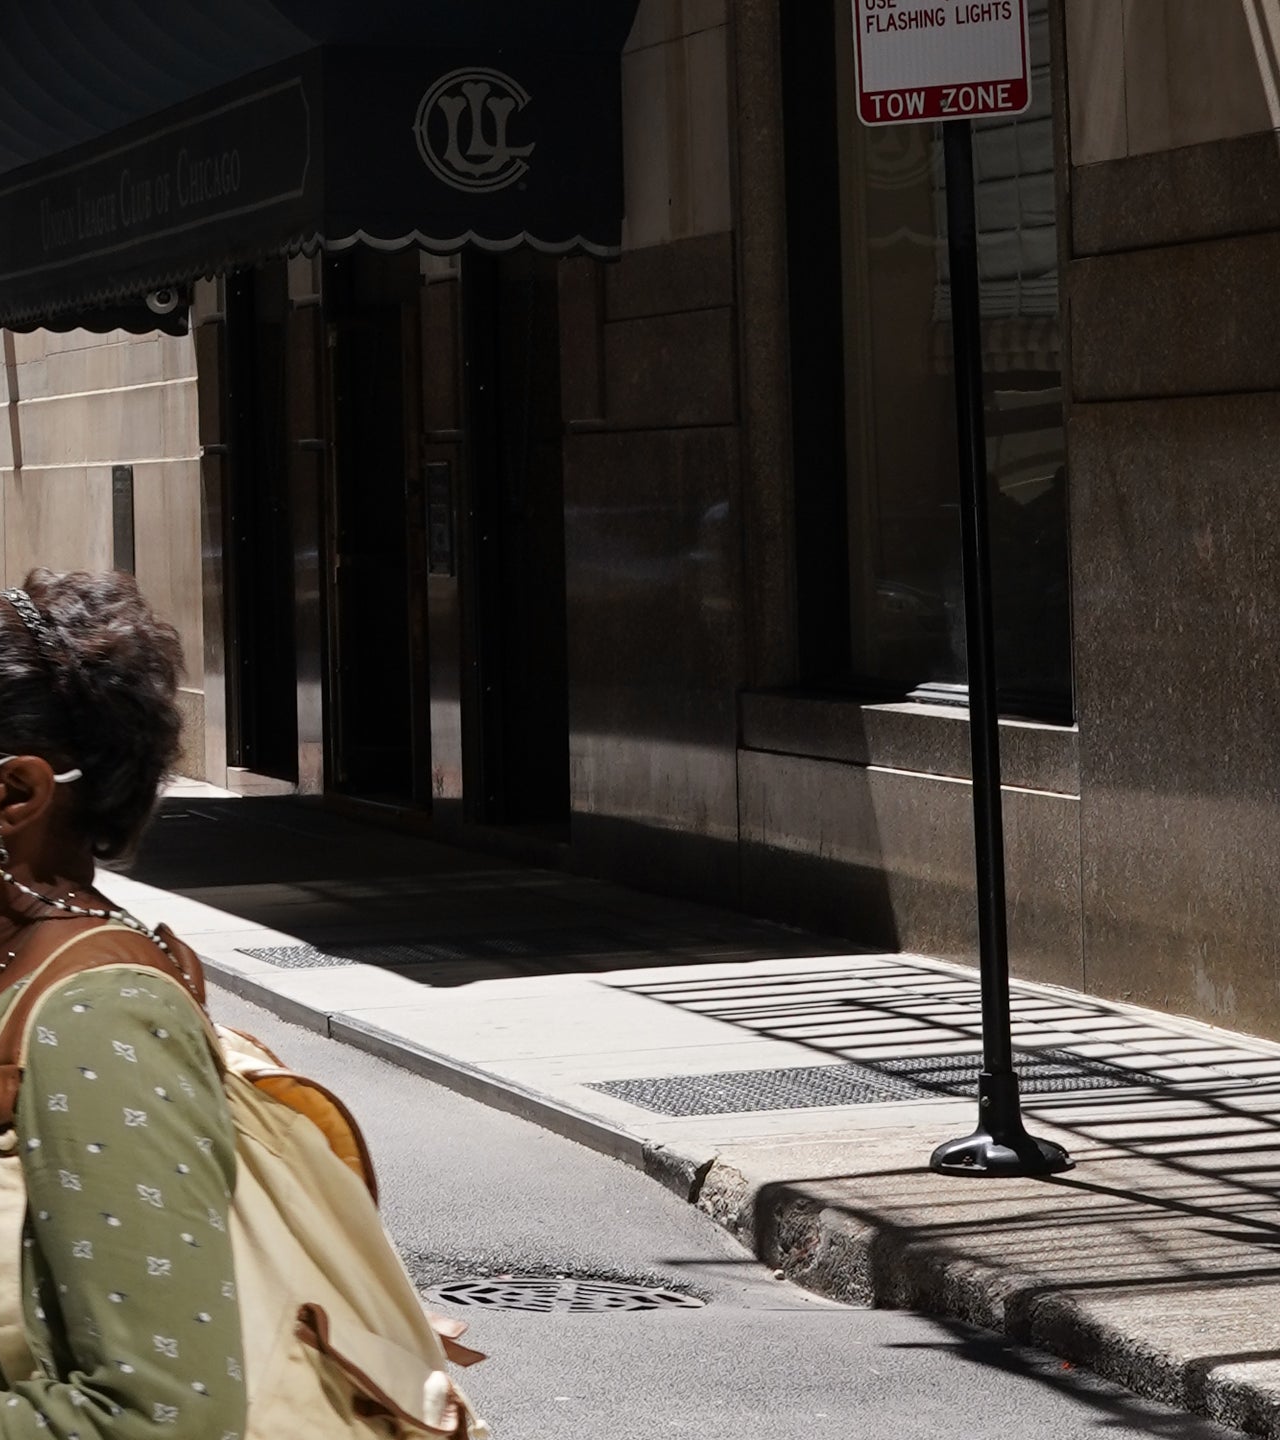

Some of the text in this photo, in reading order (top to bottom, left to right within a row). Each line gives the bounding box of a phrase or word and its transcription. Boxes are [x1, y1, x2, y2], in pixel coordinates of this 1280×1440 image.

[866, 1, 1012, 34] FLASHING LIGHTS
[870, 84, 1013, 118] TOW ZONE
[176, 146, 240, 208] CHICAGO
